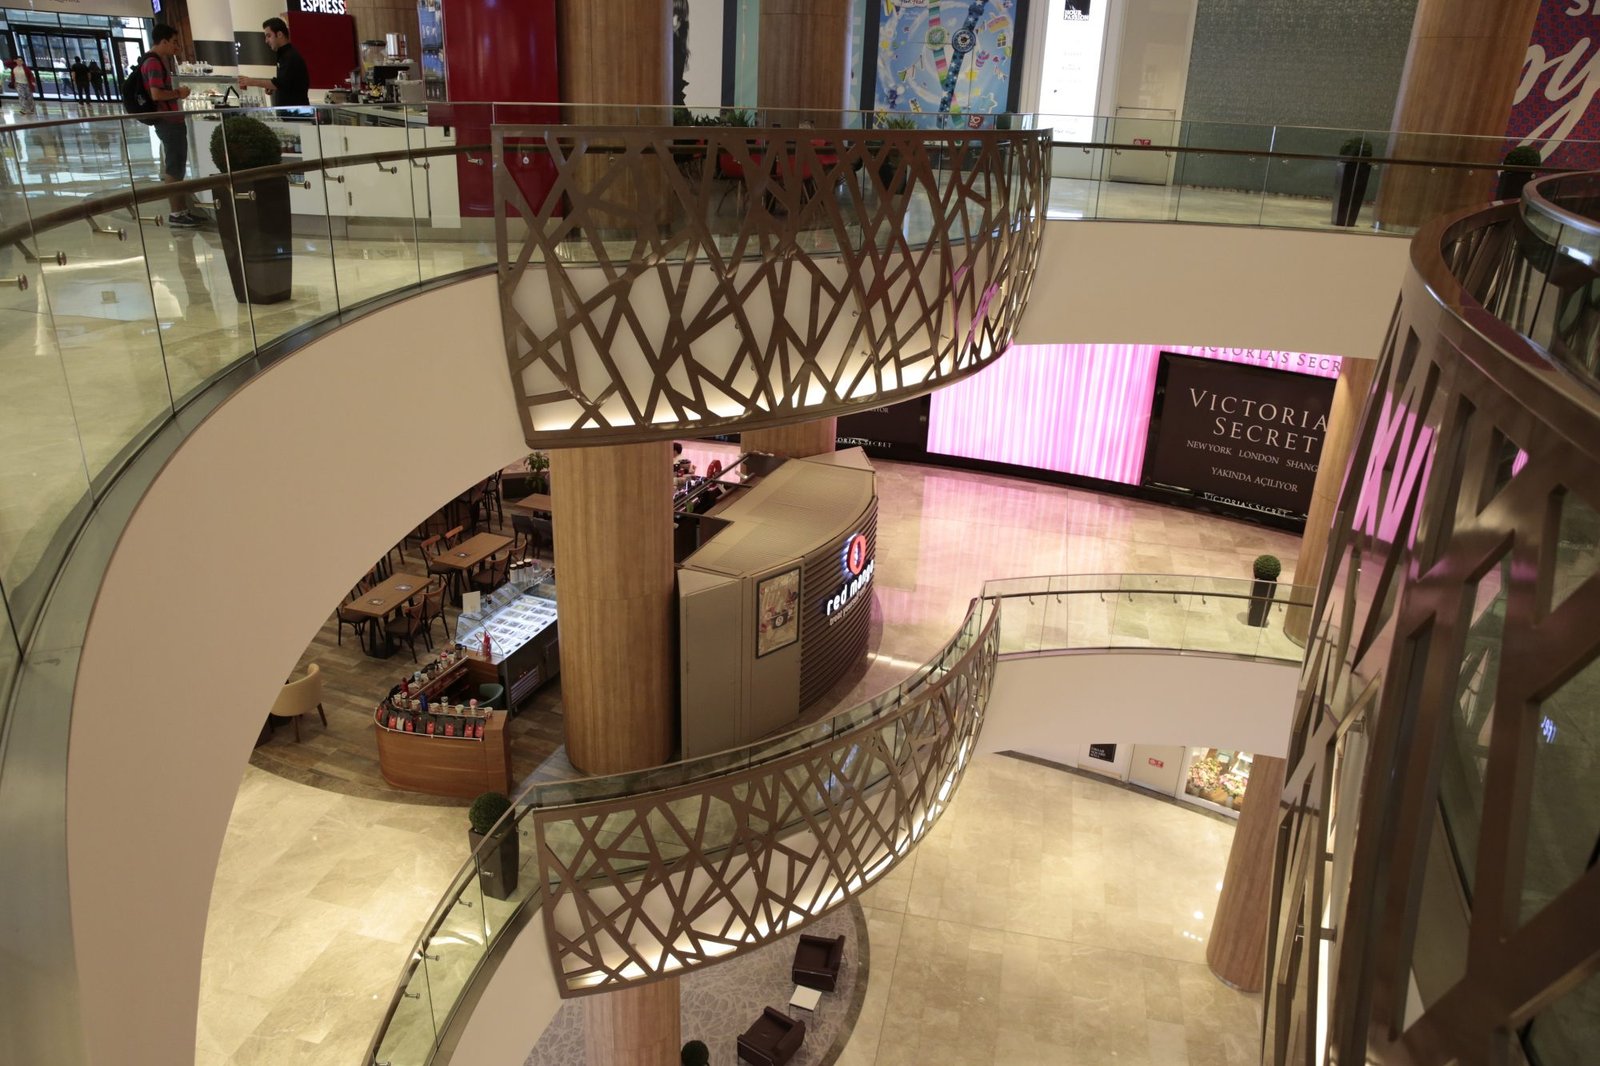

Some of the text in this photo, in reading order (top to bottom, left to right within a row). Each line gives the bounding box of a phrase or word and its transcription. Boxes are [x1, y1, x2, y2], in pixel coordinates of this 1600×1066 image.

[1189, 387, 1328, 433] VICTORIA
[1212, 416, 1318, 454] SECRET
[1186, 439, 1208, 450] NEW
[1208, 444, 1232, 456] YORK
[1238, 449, 1280, 465] LONDON
[1211, 466, 1298, 493] YAKINDA AÇILIYOR
[826, 584, 848, 616] red
